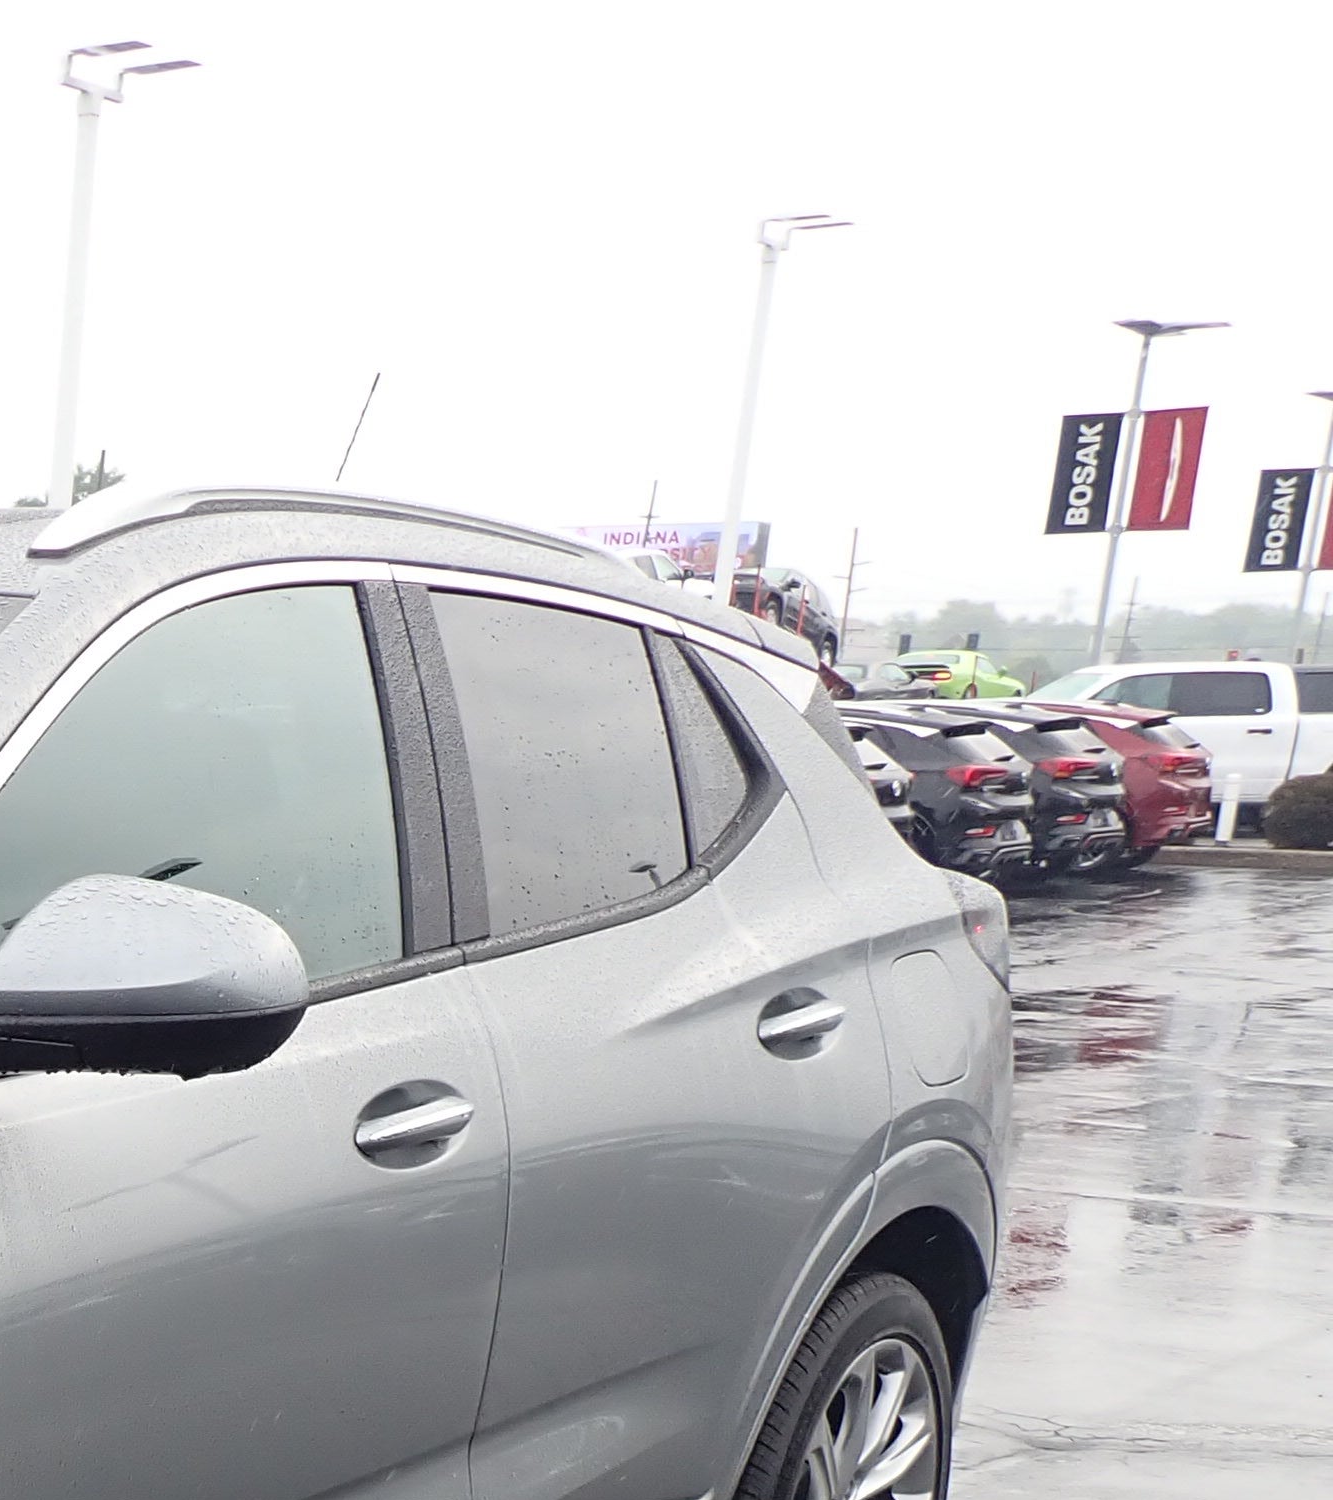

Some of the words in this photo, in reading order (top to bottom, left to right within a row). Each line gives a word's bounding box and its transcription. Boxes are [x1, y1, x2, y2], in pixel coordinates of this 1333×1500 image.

[1063, 421, 1105, 527] BOSAK
[603, 531, 680, 546] INDIANA
[1260, 475, 1299, 567] BOSAK
